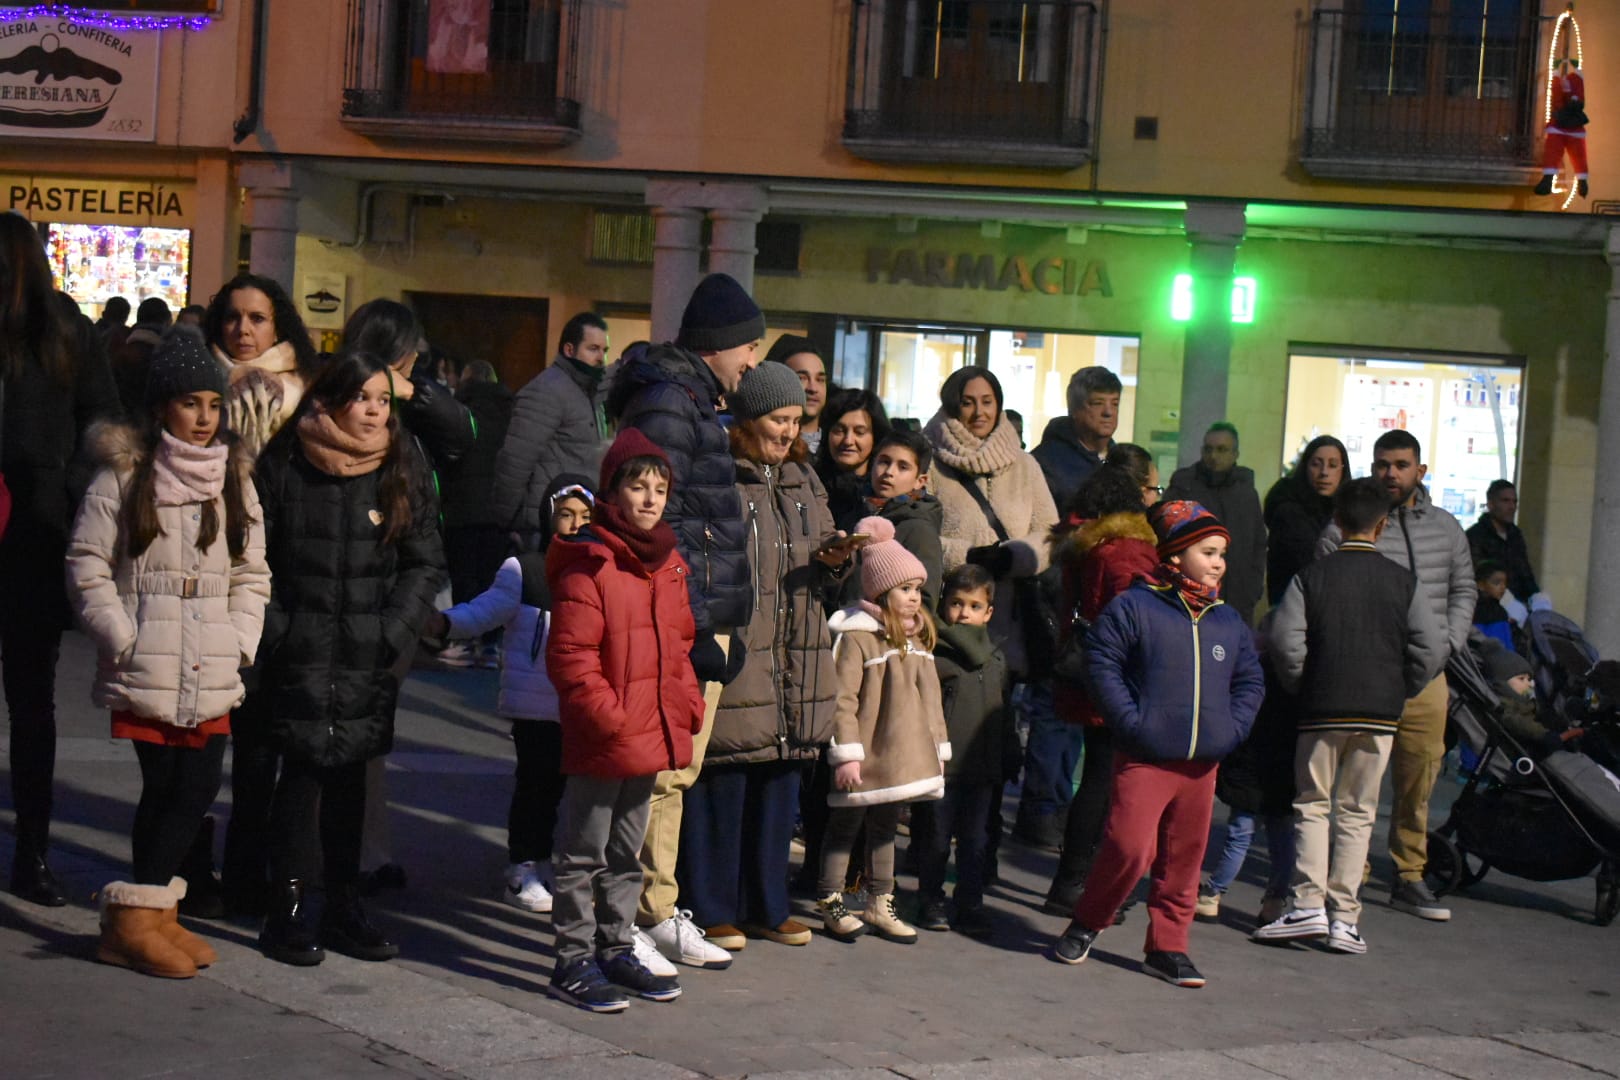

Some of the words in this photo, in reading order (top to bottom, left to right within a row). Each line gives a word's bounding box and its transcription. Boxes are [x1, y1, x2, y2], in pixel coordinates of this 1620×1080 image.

[58, 22, 132, 57] CONFITERIA
[0, 85, 101, 103] ERESIANA
[10, 186, 183, 217] PASTELERÍA
[866, 248, 1113, 297] FARMACIA
